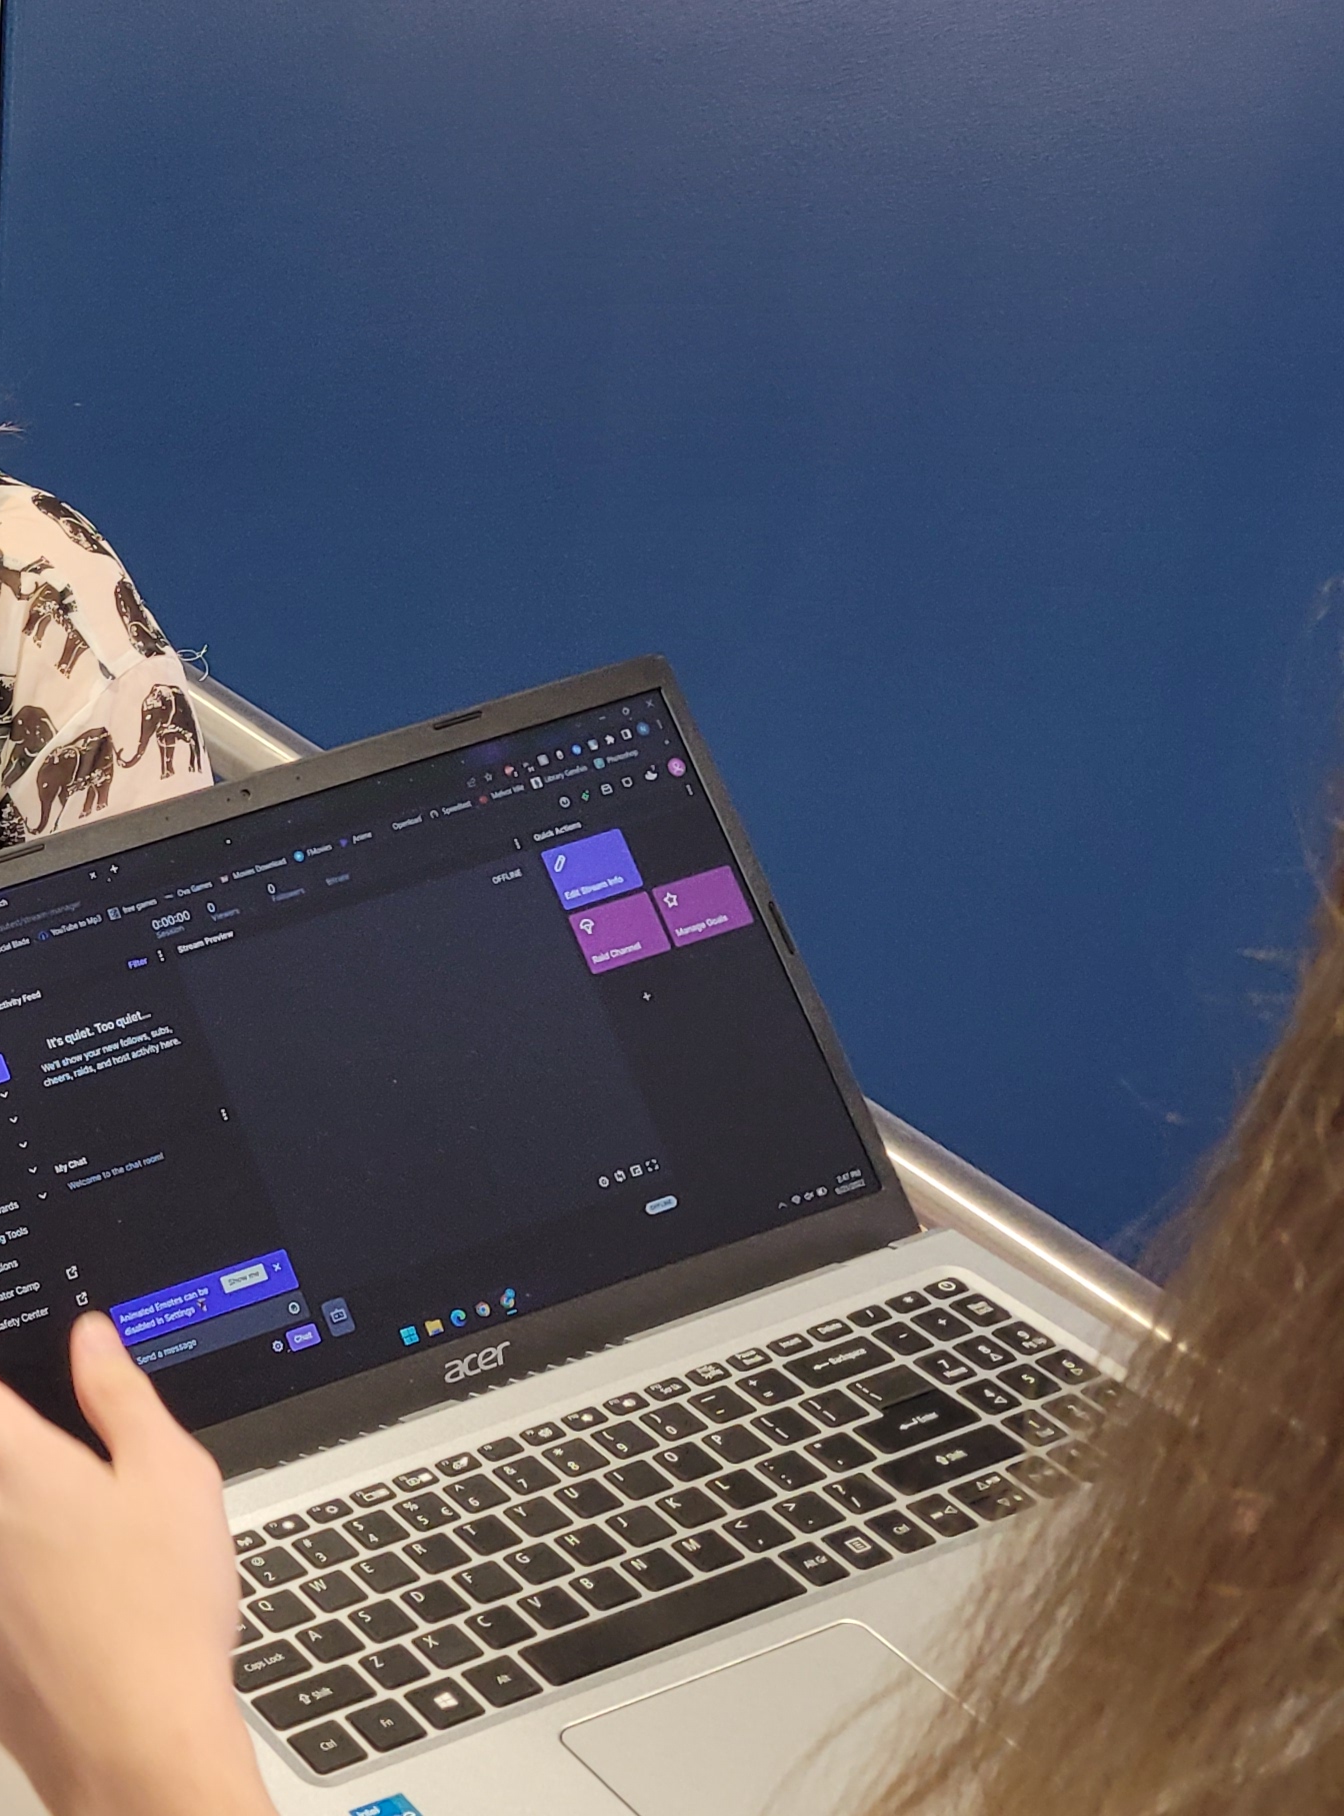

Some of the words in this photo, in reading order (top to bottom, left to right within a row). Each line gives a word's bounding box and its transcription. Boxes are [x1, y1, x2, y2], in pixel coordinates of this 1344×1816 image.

[534, 830, 554, 841] Quick
[555, 822, 581, 835] Actions
[492, 869, 522, 884] OFFLINE
[265, 884, 277, 894] 0
[564, 889, 581, 900] Edit
[580, 882, 608, 894] Stream
[607, 876, 624, 886] Info
[205, 903, 217, 912] 0
[50, 923, 78, 935] YouTube
[86, 915, 102, 924] Mp3
[152, 910, 190, 930] 0:00:00
[675, 922, 706, 936] Manage
[706, 915, 728, 926] Goals
[12, 938, 30, 948] Blade
[177, 941, 204, 953] Stream
[204, 931, 233, 945] Preview
[592, 952, 610, 964] Raid
[610, 942, 642, 958] Channel
[128, 958, 147, 969] Filter
[22, 990, 41, 1002] Feed
[46, 1037, 64, 1049] It's
[65, 1028, 94, 1044] quiet.
[94, 1022, 114, 1033] Too
[41, 1060, 61, 1072] We'll
[62, 1054, 82, 1066] show
[83, 1048, 101, 1061] your
[102, 1042, 119, 1053] new
[120, 1033, 151, 1047] follows,
[151, 1026, 173, 1038] subs,
[44, 1073, 73, 1086] cheers,
[73, 1066, 96, 1077] raids,
[97, 1058, 112, 1070] and
[112, 1053, 131, 1064] host
[131, 1044, 159, 1058] activity
[159, 1038, 181, 1049] here.
[55, 1164, 67, 1173] My
[68, 1157, 87, 1168] Chat
[67, 1174, 102, 1190] Welcome
[111, 1167, 124, 1175] the
[125, 1160, 142, 1171] chat
[5, 1227, 28, 1239] Tools
[228, 1276, 247, 1286] Show
[16, 1282, 40, 1294] Camp
[120, 1305, 154, 1323] Animated
[154, 1297, 183, 1311] Emotes
[184, 1292, 198, 1301] can
[197, 1288, 208, 1296] be
[21, 1308, 48, 1322] Center
[125, 1319, 156, 1336] disabled
[164, 1307, 195, 1322] Settings
[817, 1323, 842, 1334] Delete
[294, 1332, 312, 1343] Chat
[779, 1338, 802, 1348] Insert
[136, 1352, 156, 1365] Send
[164, 1340, 196, 1356] message
[828, 1348, 866, 1364] Backspace
[444, 1341, 511, 1384] acer
[915, 1412, 938, 1423] Enter
[709, 1435, 727, 1445] P
[664, 1452, 678, 1462] O
[946, 1450, 967, 1461] Shift
[613, 1472, 623, 1481] I
[715, 1481, 730, 1490] L
[564, 1488, 578, 1498] U
[665, 1498, 681, 1508] K
[514, 1506, 526, 1516] Y
[463, 1525, 476, 1535] T
[893, 1524, 910, 1534] Ctrl
[564, 1535, 580, 1546] H
[682, 1539, 700, 1551] M
[412, 1544, 426, 1554] R
[516, 1553, 530, 1563] G
[360, 1563, 374, 1573] E
[804, 1560, 818, 1568] Alt
[309, 1579, 326, 1592] W
[580, 1578, 594, 1589] B
[410, 1592, 424, 1602] D
[258, 1600, 274, 1610] Q
[358, 1611, 371, 1622] S
[477, 1616, 491, 1626] C
[308, 1630, 322, 1641] A
[244, 1661, 266, 1672] Caps
[264, 1653, 285, 1664] Lock
[497, 1675, 511, 1684] Alt
[312, 1688, 333, 1700] Shift
[380, 1719, 394, 1727] Fn
[320, 1739, 337, 1750] Ctrl
